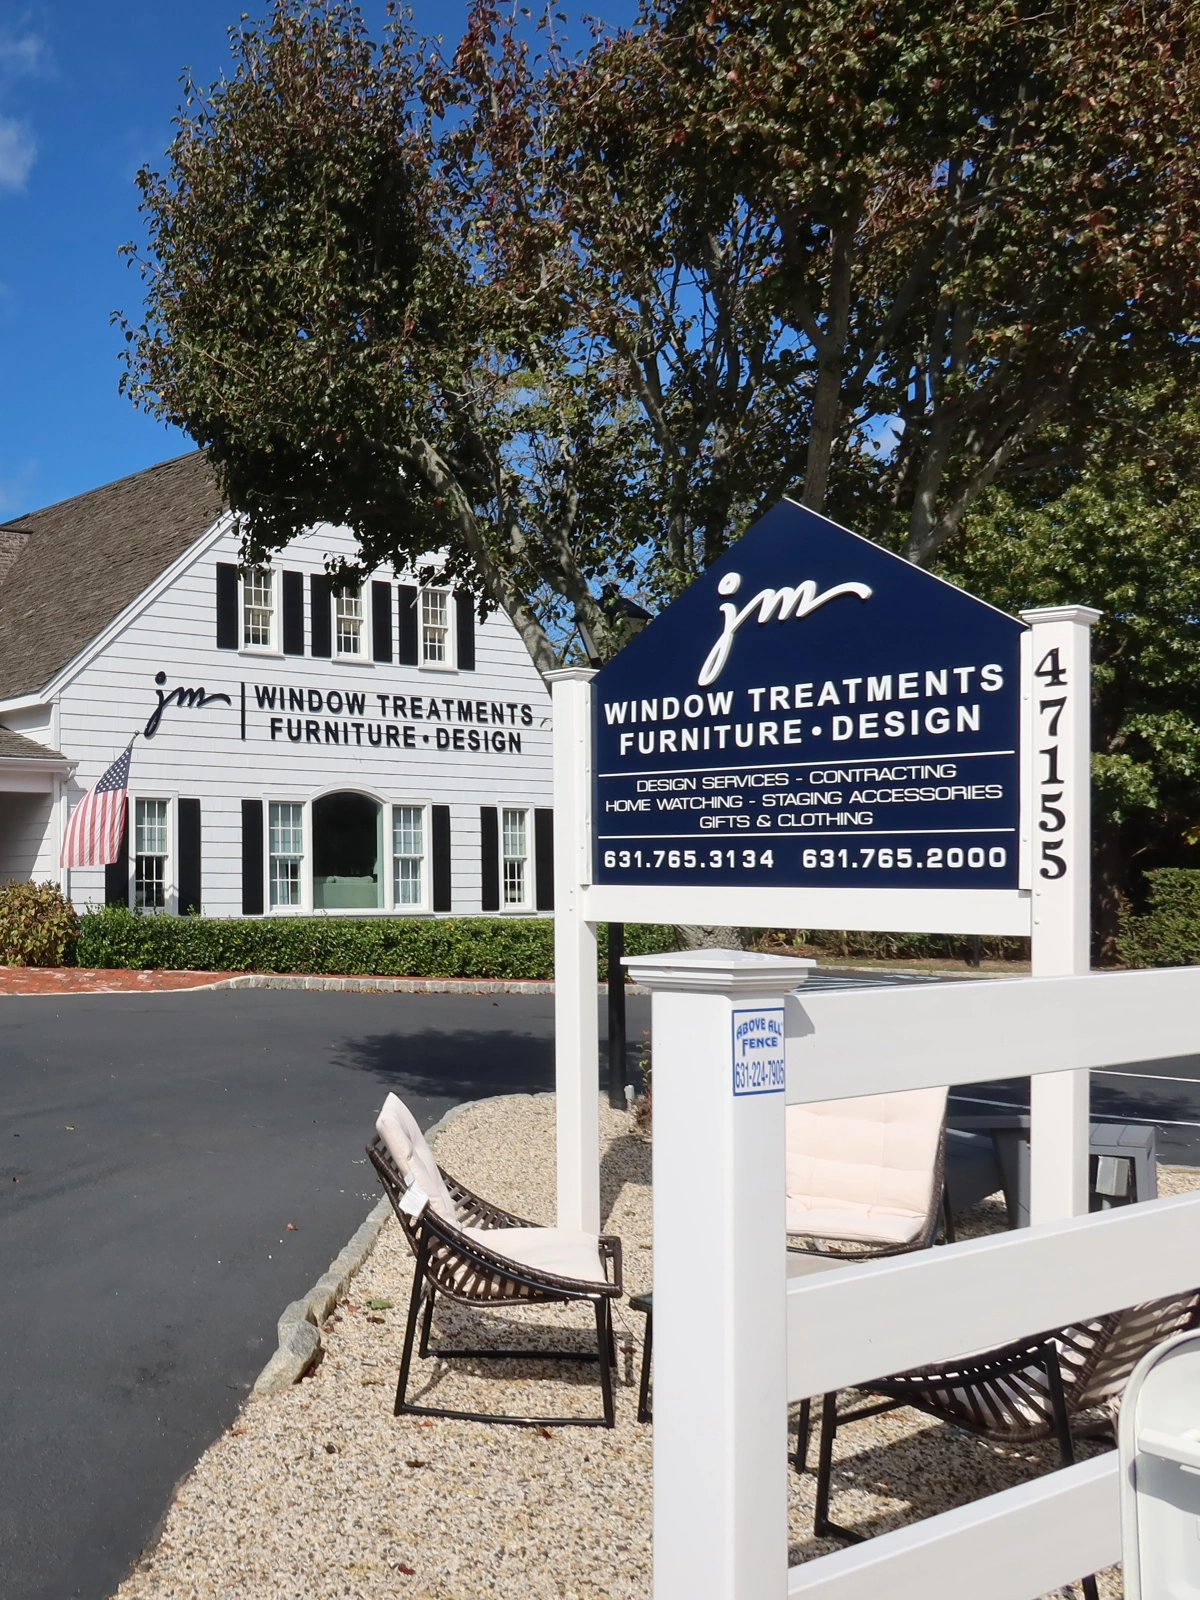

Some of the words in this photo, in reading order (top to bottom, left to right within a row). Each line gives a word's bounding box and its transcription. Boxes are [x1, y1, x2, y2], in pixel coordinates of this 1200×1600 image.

[698, 572, 872, 687] jm
[144, 671, 231, 738] jm
[254, 685, 365, 715] WINDOW
[377, 695, 533, 726] TREATMENTS
[604, 691, 734, 725] WINDOW
[748, 664, 1004, 712] TREATMENTS
[271, 718, 416, 747] FURNITURE
[436, 728, 521, 753] DESIGN
[620, 719, 802, 756] FURNITURE
[832, 704, 980, 741] DESIGN
[637, 778, 696, 792] DESIGN
[702, 773, 789, 789] SERVICES
[809, 764, 957, 784] CONTRACTING
[1034, 647, 1068, 880] 47155
[605, 799, 651, 812] HOME
[656, 795, 743, 810] WATCHING
[762, 791, 842, 807] STAGING
[849, 784, 1003, 804] ACCESSORIES
[700, 815, 750, 829] GIFTS
[756, 814, 771, 827] &
[777, 811, 874, 827] CLOTHING
[604, 850, 774, 868] 631.765.3134
[802, 847, 1006, 868] 631.765.2000
[736, 1018, 766, 1040] ABOVE
[768, 1019, 782, 1036] ALL
[742, 1037, 778, 1057] FENCE
